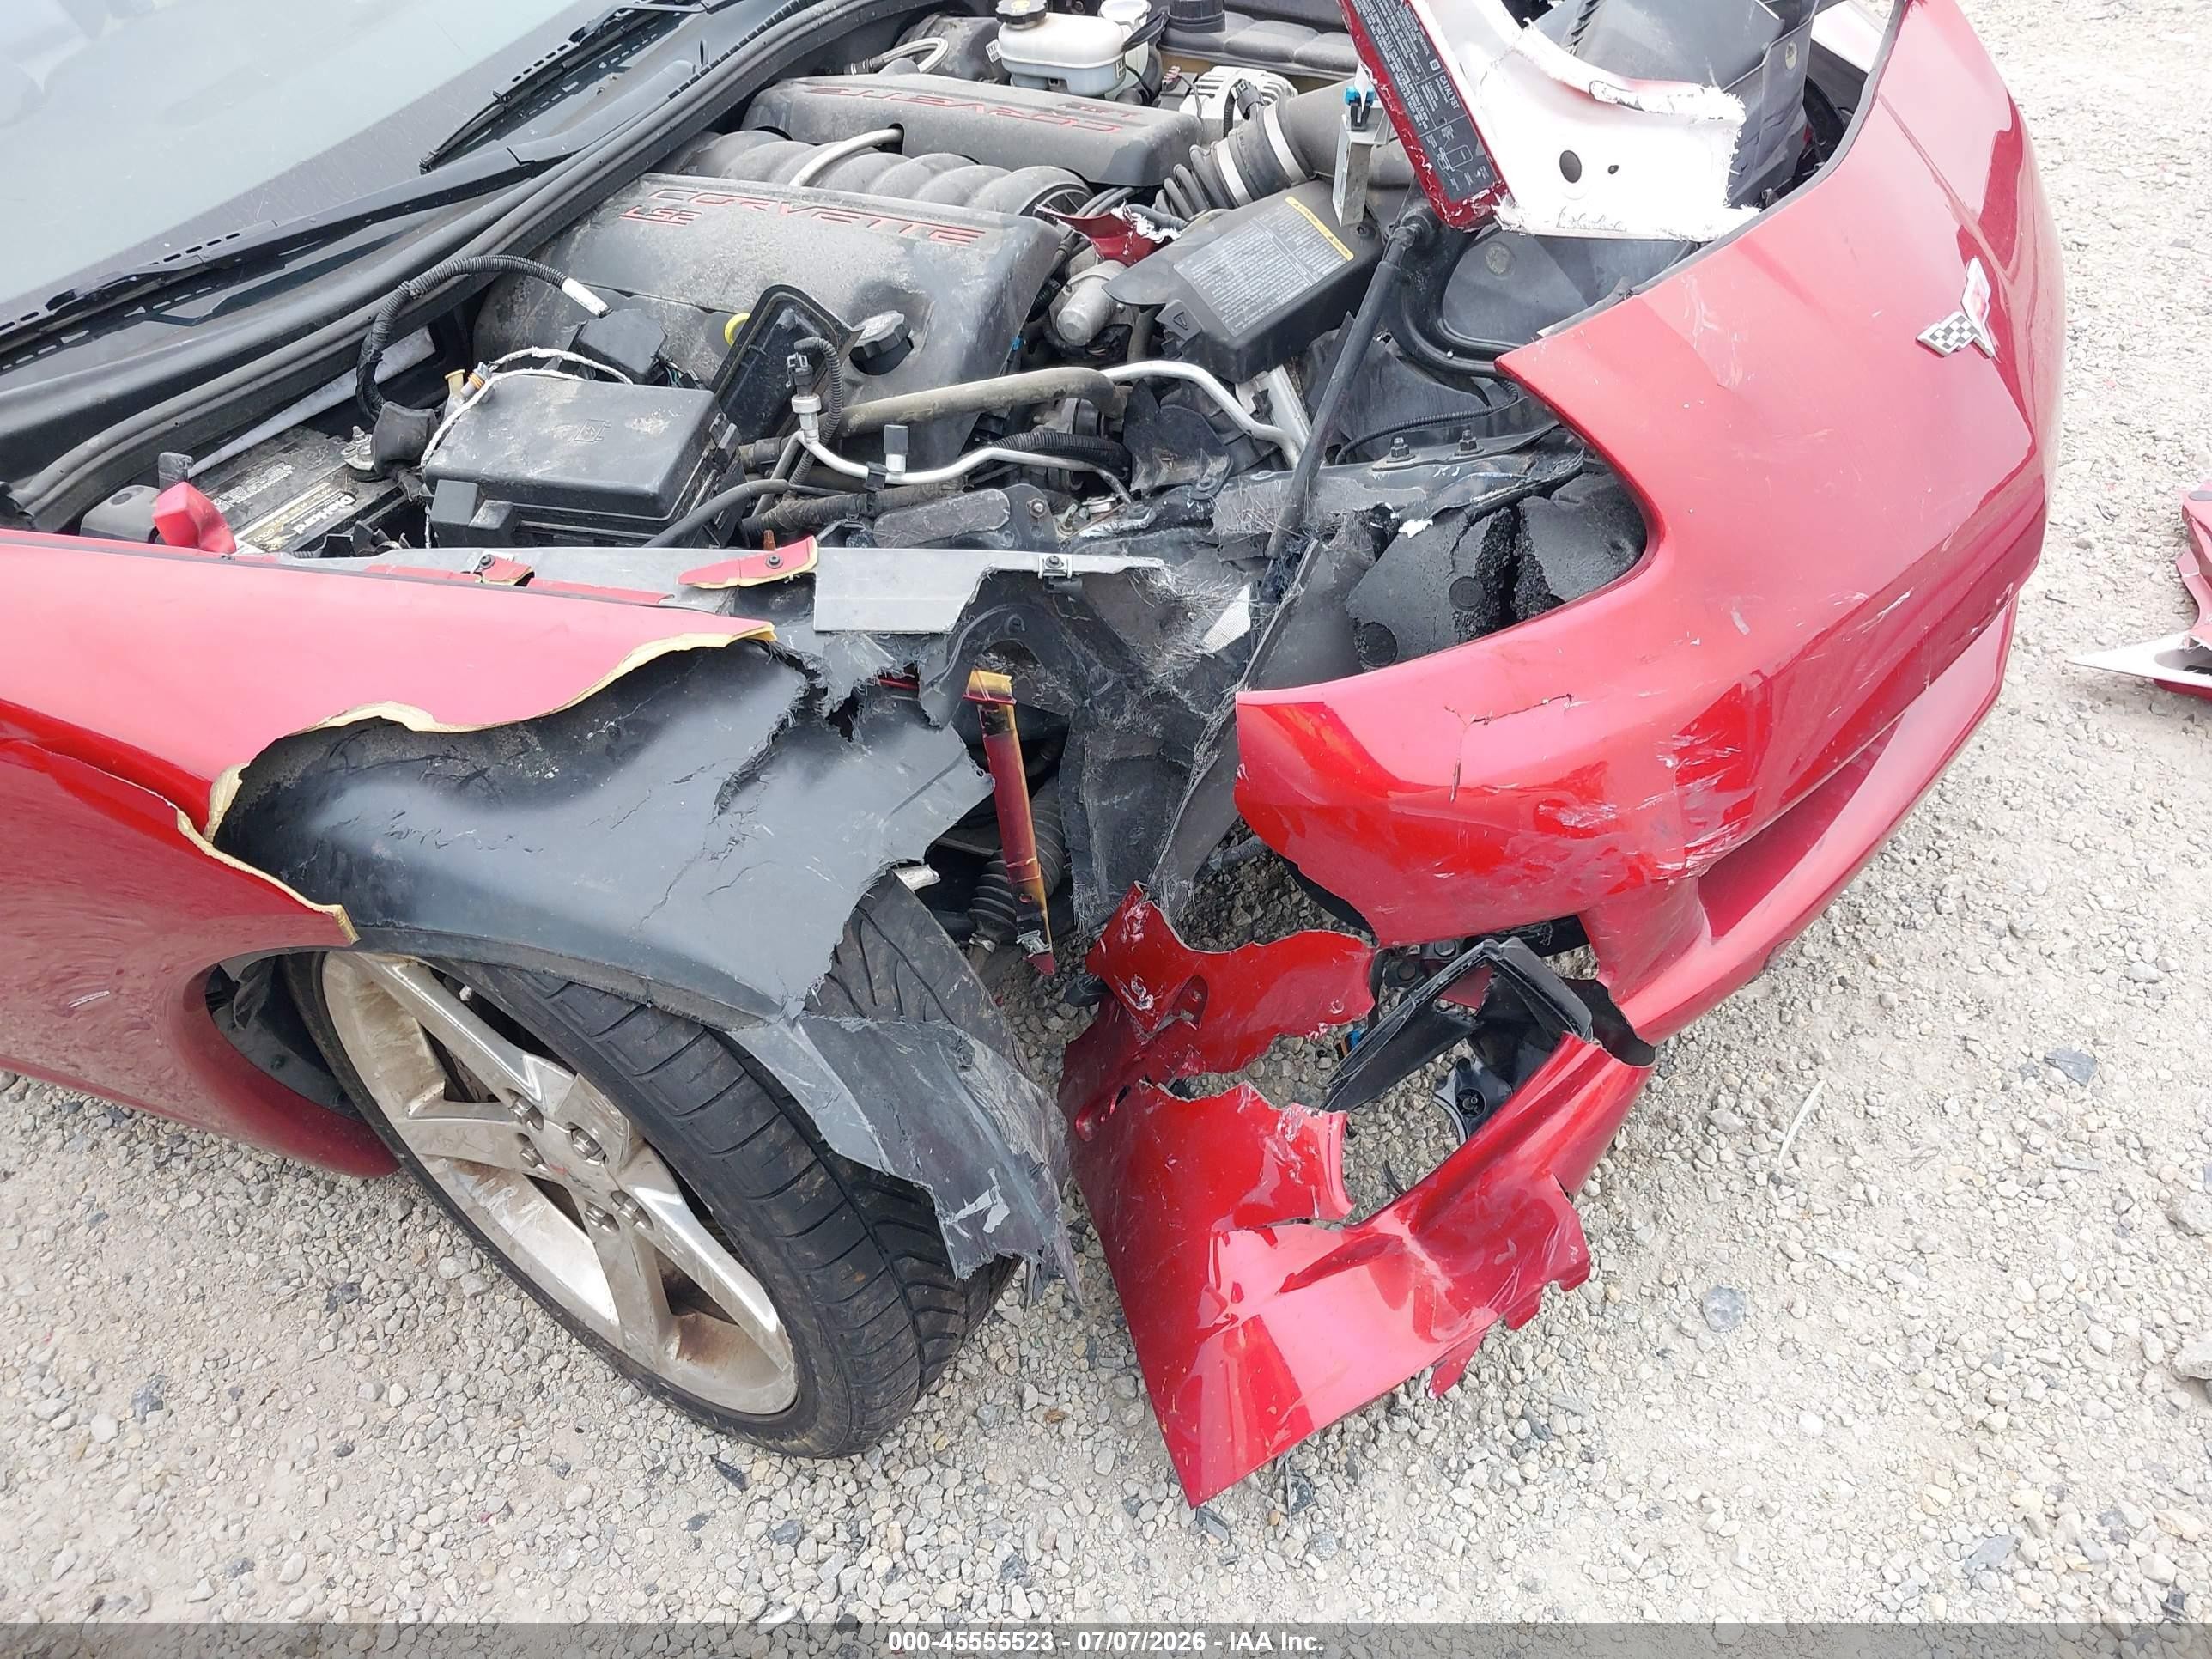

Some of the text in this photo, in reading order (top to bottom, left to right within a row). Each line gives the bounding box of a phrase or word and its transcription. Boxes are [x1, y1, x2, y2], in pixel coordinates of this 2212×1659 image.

[804, 88, 1122, 131] CORVETTE
[1437, 74, 1461, 110] CATALYST
[618, 204, 702, 226] LS2
[649, 188, 986, 246] CORVETTE
[292, 491, 357, 536] DieHard
[253, 527, 275, 543] GOLD
